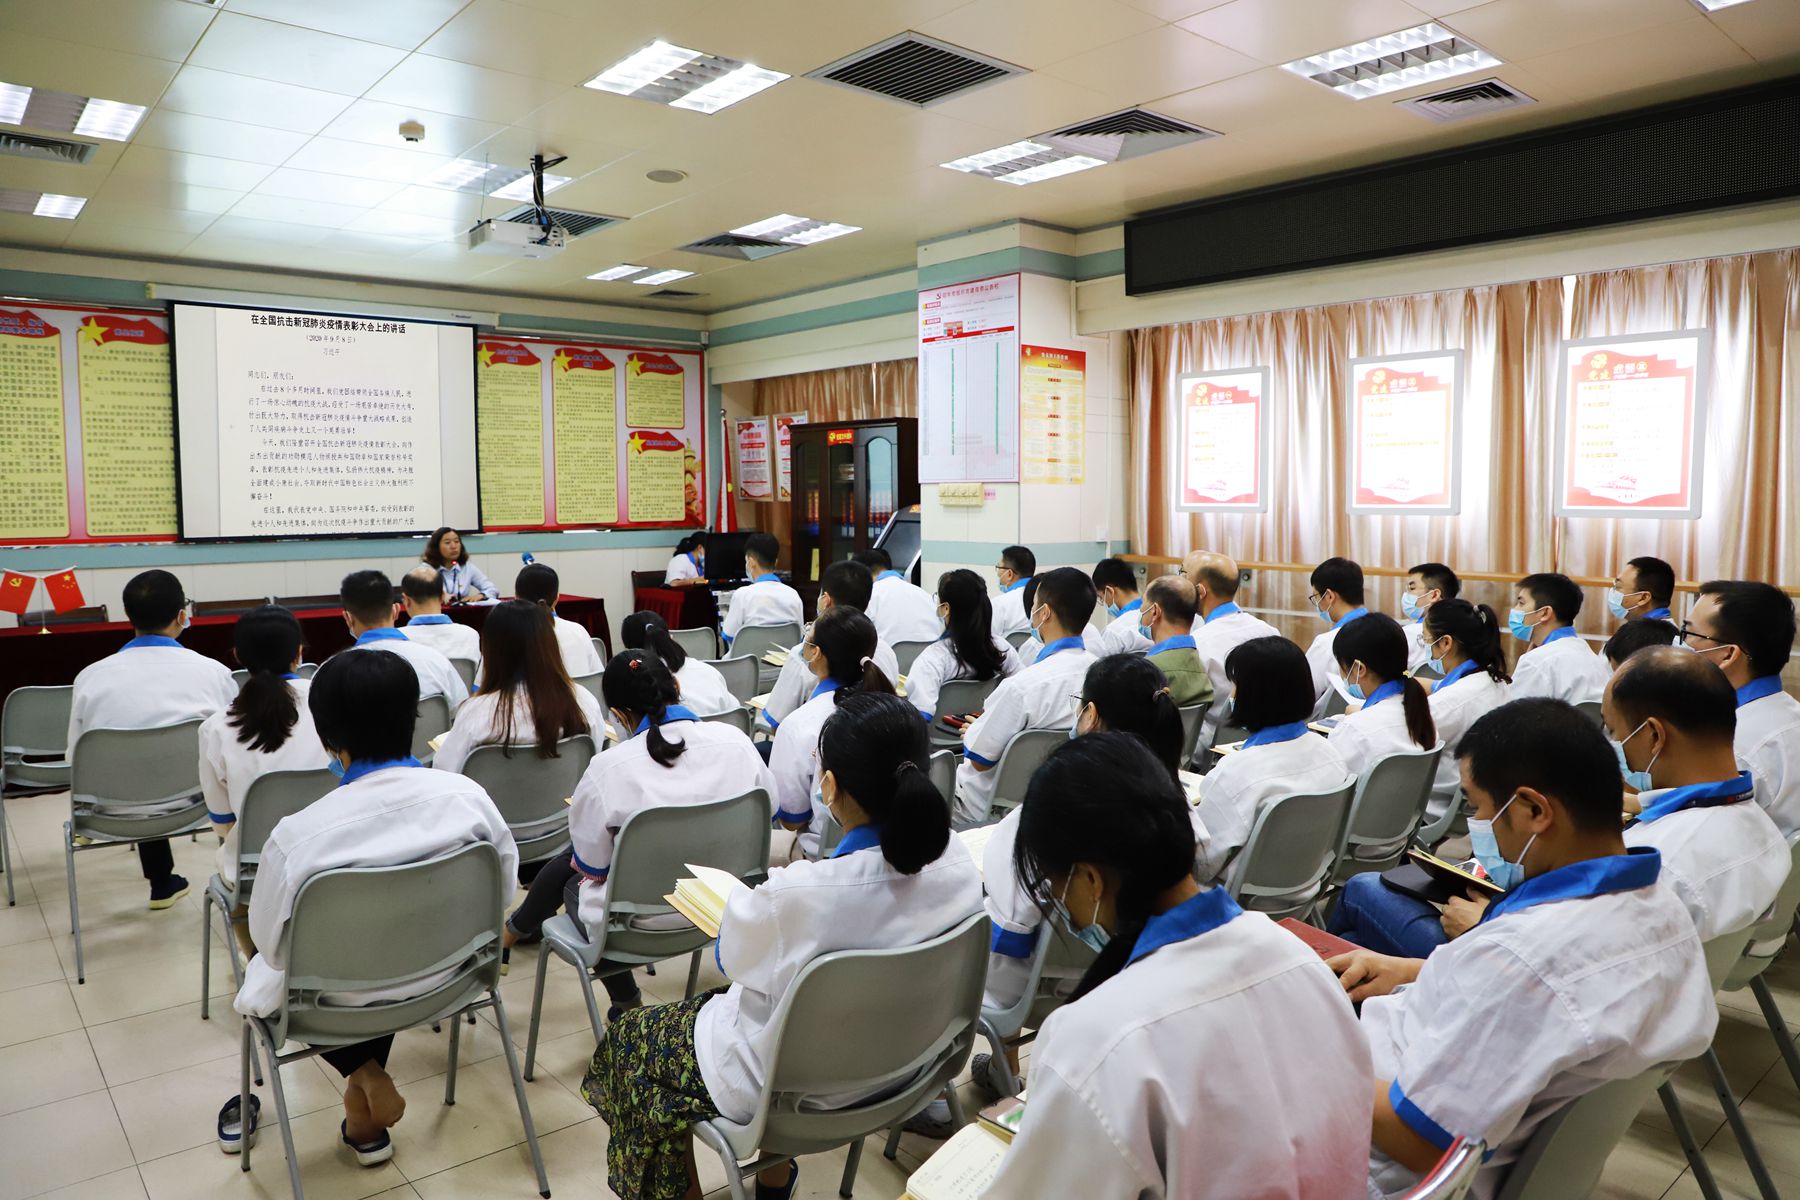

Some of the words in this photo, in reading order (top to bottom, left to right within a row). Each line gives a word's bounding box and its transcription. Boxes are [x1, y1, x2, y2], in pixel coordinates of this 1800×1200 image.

[250, 313, 406, 334] 在全国抗击新冠肺炎疫情表彰大会上的讲话
